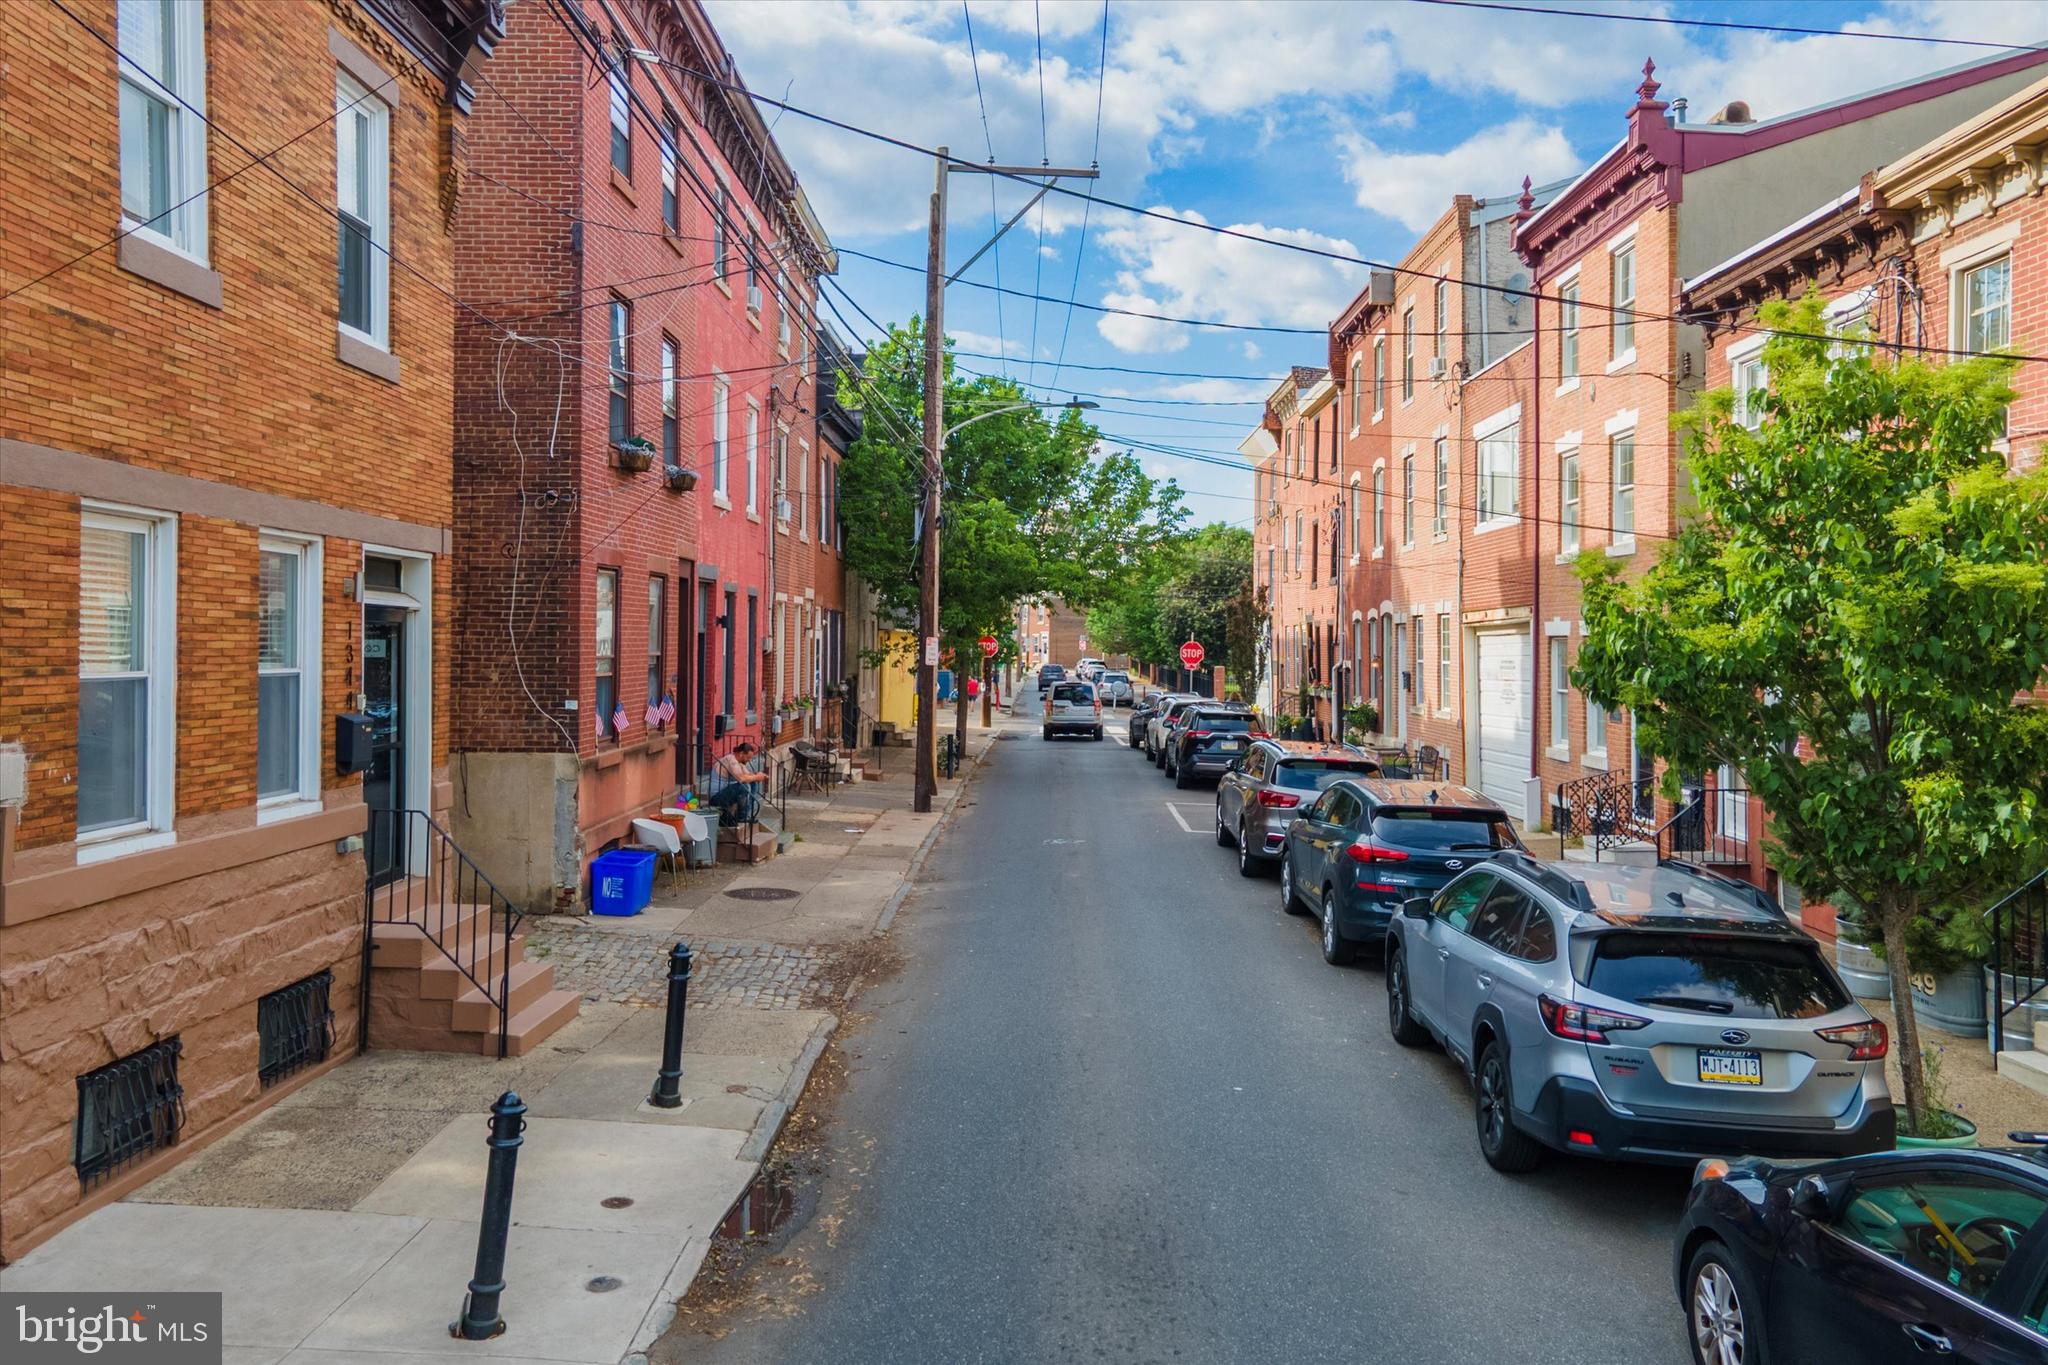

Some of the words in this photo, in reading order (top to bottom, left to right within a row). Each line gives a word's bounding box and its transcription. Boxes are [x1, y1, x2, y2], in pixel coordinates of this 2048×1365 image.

[1182, 649, 1202, 658] STOP
[1380, 876, 1407, 884] TUCSON
[1907, 972, 1937, 997] 49
[1604, 1055, 1645, 1065] SUBARU
